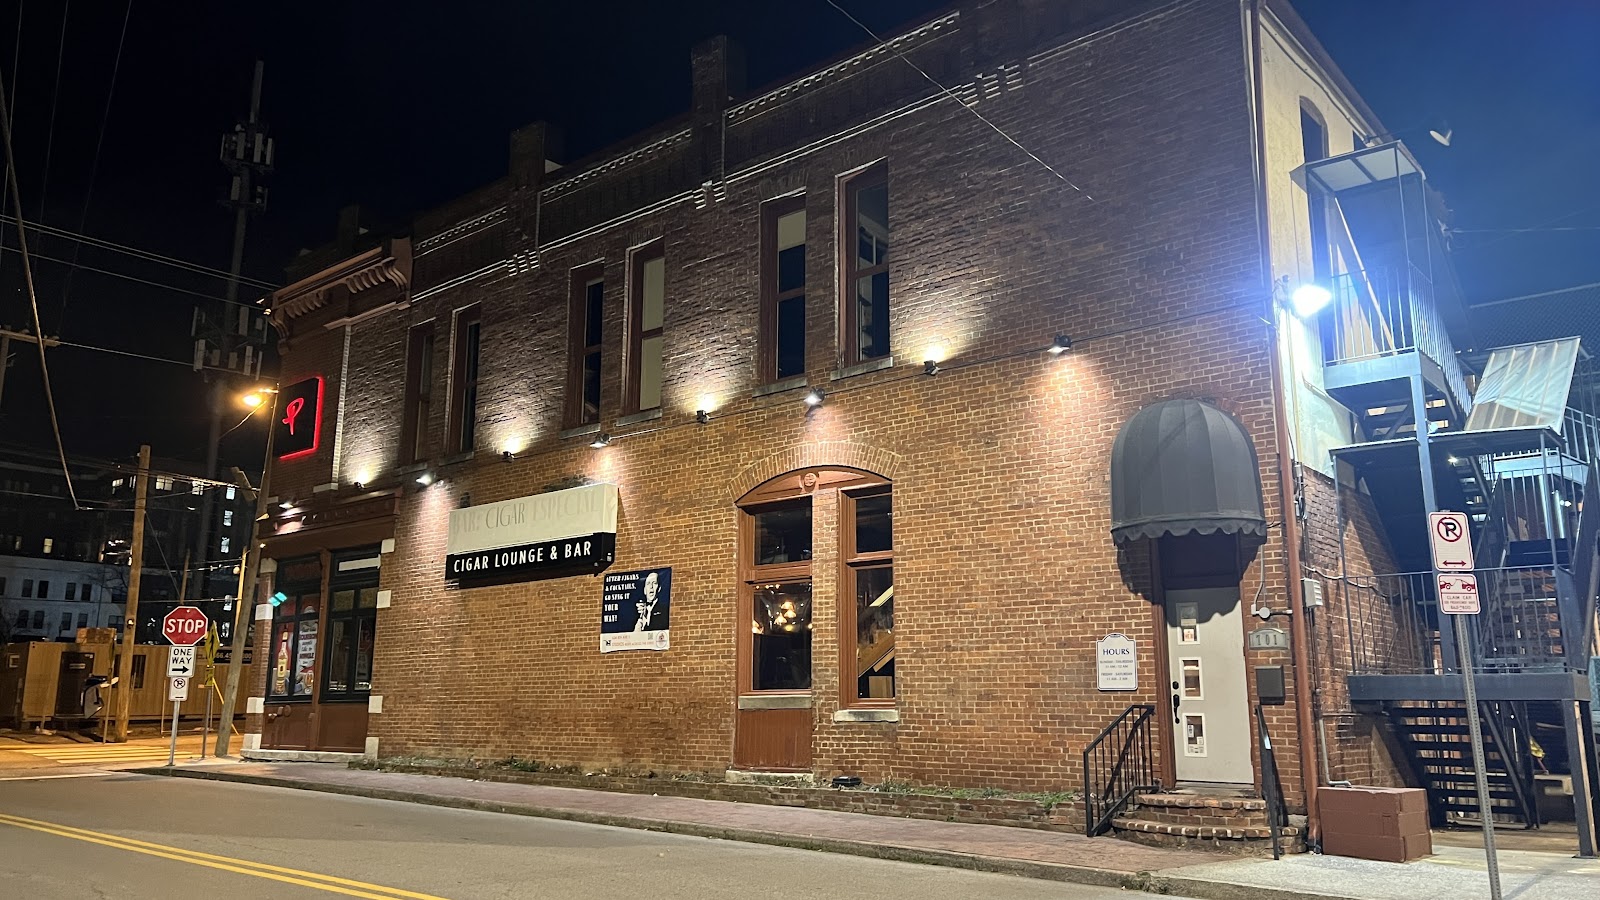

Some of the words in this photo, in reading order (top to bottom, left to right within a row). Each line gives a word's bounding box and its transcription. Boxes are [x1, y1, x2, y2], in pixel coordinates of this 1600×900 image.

[485, 502, 525, 529] CIGAR
[453, 556, 489, 573] CIGAR
[495, 548, 544, 568] LOUNGE
[550, 546, 558, 560] &
[564, 541, 592, 559] BAR
[166, 618, 205, 634] STOP
[173, 648, 192, 656] ONE
[172, 657, 192, 665] WAY
